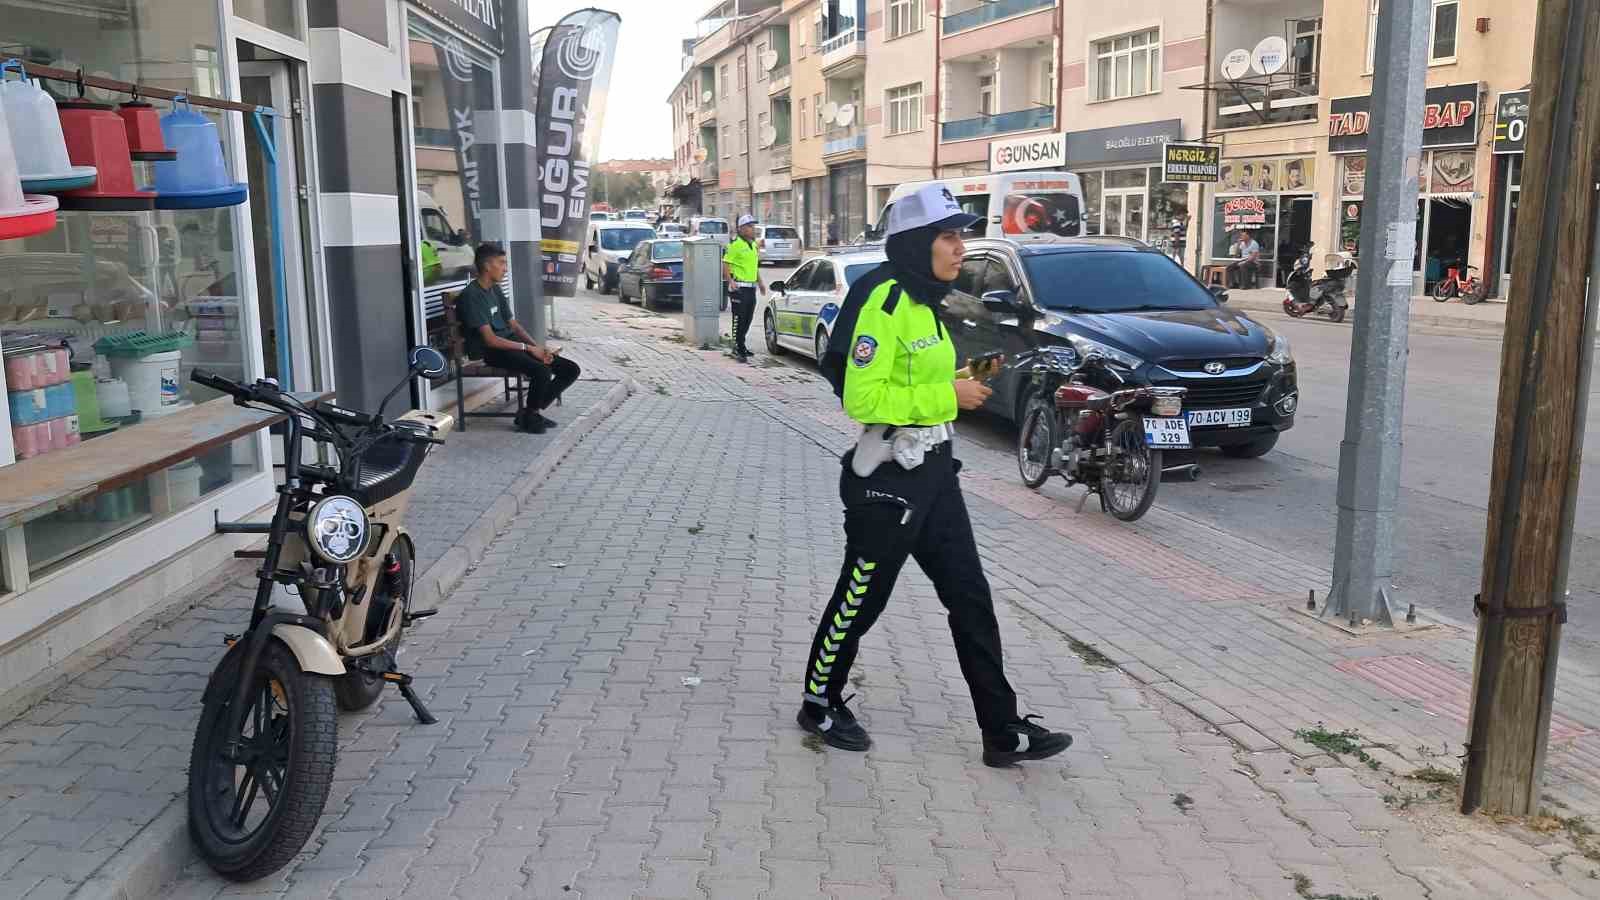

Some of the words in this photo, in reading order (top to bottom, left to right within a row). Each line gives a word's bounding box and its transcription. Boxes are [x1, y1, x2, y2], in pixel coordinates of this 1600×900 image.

[538, 86, 578, 228] UĞUR
[1190, 411, 1203, 425] 70
[1206, 410, 1226, 423] ACV
[1231, 409, 1250, 422] 199
[1165, 418, 1185, 431] ADE
[1160, 432, 1181, 443] 329
